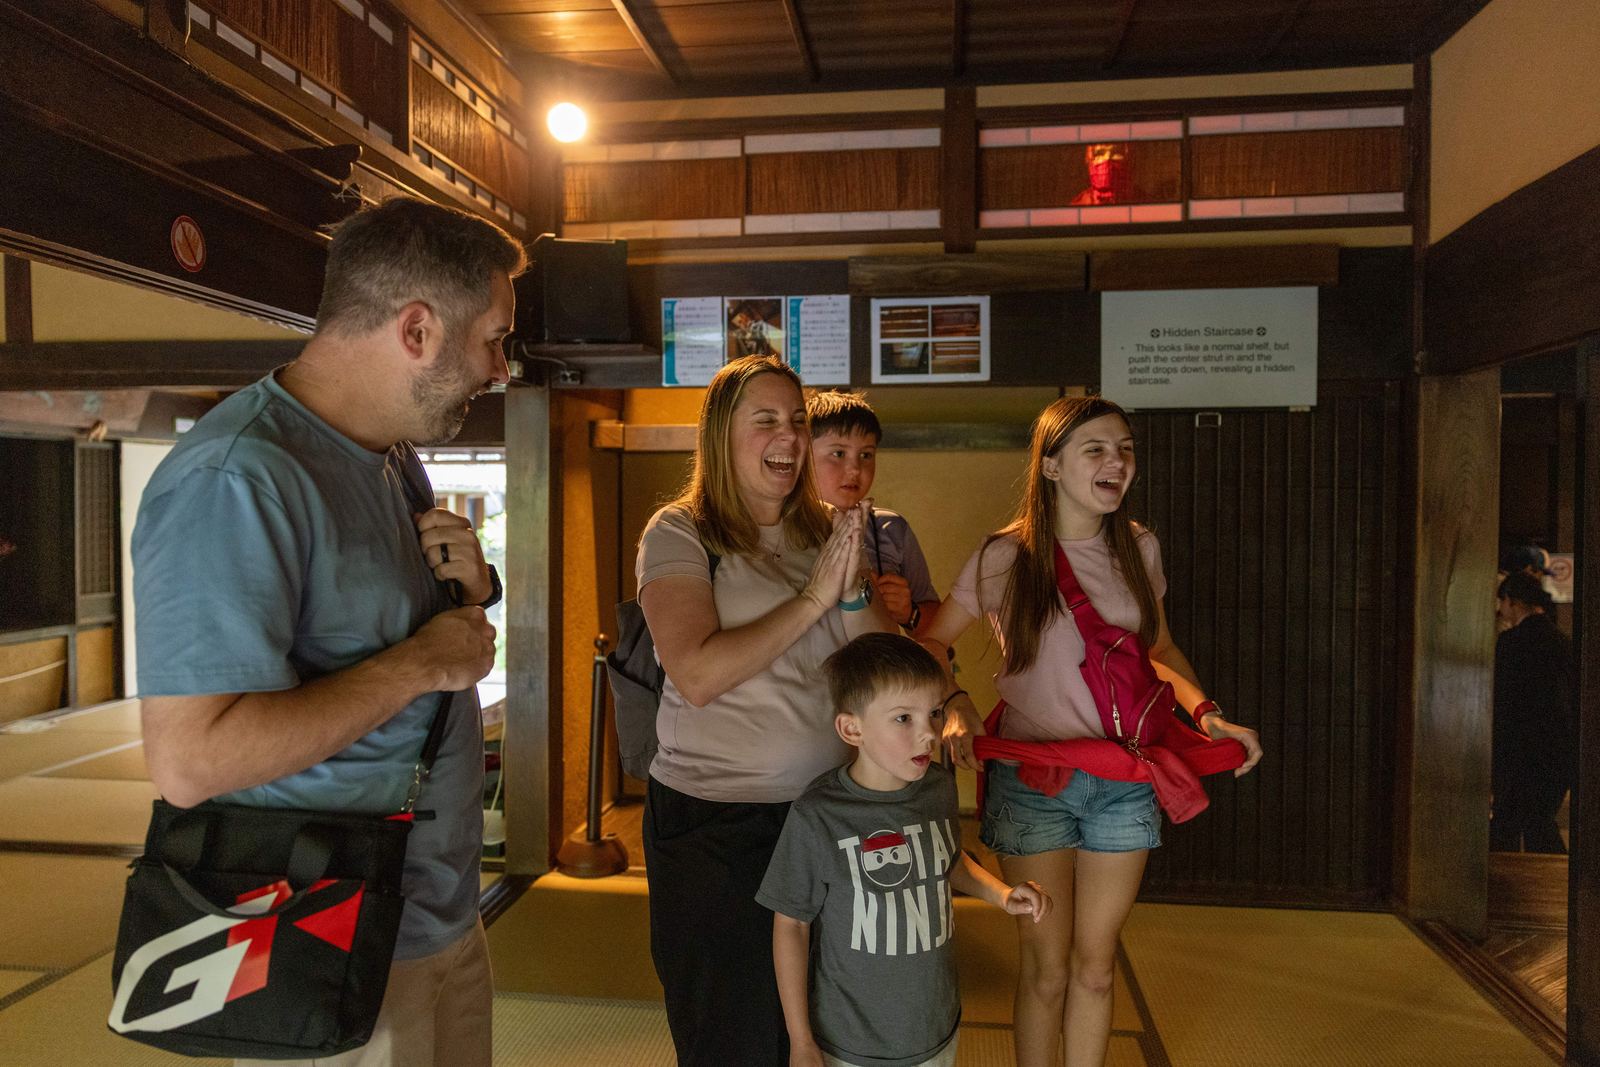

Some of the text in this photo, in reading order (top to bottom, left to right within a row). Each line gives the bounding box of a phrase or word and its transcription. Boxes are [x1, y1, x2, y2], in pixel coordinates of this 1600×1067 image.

[1163, 326, 1254, 336] Hidden Staircase
[1136, 344, 1154, 352] This
[1157, 344, 1181, 352] looks
[1212, 342, 1244, 350] normal
[1246, 342, 1271, 351] shelf,
[1274, 342, 1289, 350] but
[1128, 356, 1151, 364] push
[1236, 353, 1254, 361] and
[1257, 353, 1272, 361] the
[1152, 366, 1178, 375] drops
[1180, 366, 1207, 374] down,
[1210, 365, 1252, 374] revealing
[1264, 364, 1295, 372] hidden
[851, 880, 955, 956] NINJ
